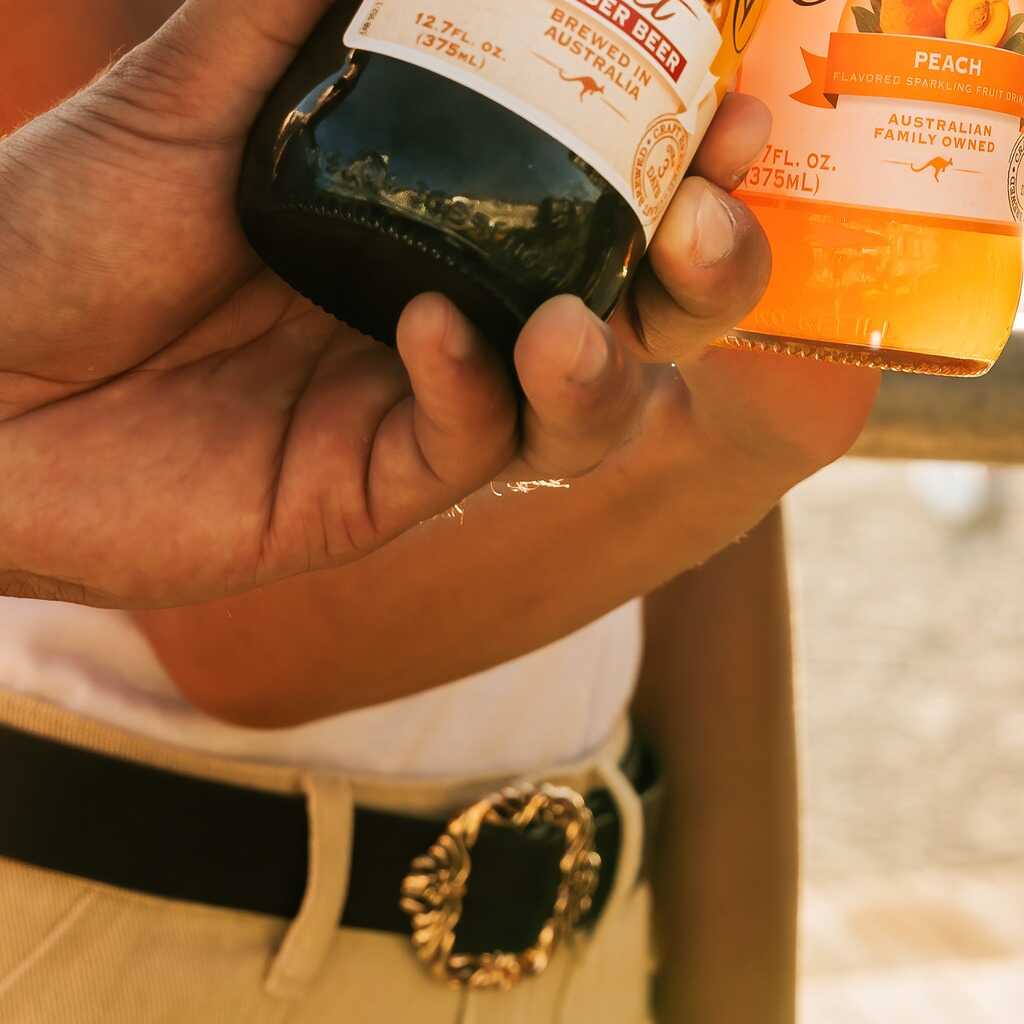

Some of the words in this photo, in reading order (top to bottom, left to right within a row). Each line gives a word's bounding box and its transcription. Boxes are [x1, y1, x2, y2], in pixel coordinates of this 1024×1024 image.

[415, 12, 475, 46] 12.7FL.
[481, 41, 506, 62] OZ.
[416, 33, 486, 69] (375ML)
[551, 8, 631, 68] BREWED
[634, 66, 652, 87] IN
[632, 17, 681, 73] BEER
[544, 26, 640, 101] AUSTRALIA
[914, 51, 982, 77] PEACH
[832, 71, 901, 85] FLAVORED
[905, 77, 972, 94] SPARKLING
[976, 86, 1004, 98] FRUIT
[888, 113, 992, 137] AUSTRALIAN
[874, 128, 937, 146] FAMILY
[942, 136, 996, 153] OWNED
[762, 145, 799, 167] 7FL.
[807, 152, 837, 171] OZ.
[744, 166, 820, 196] (375ML)
